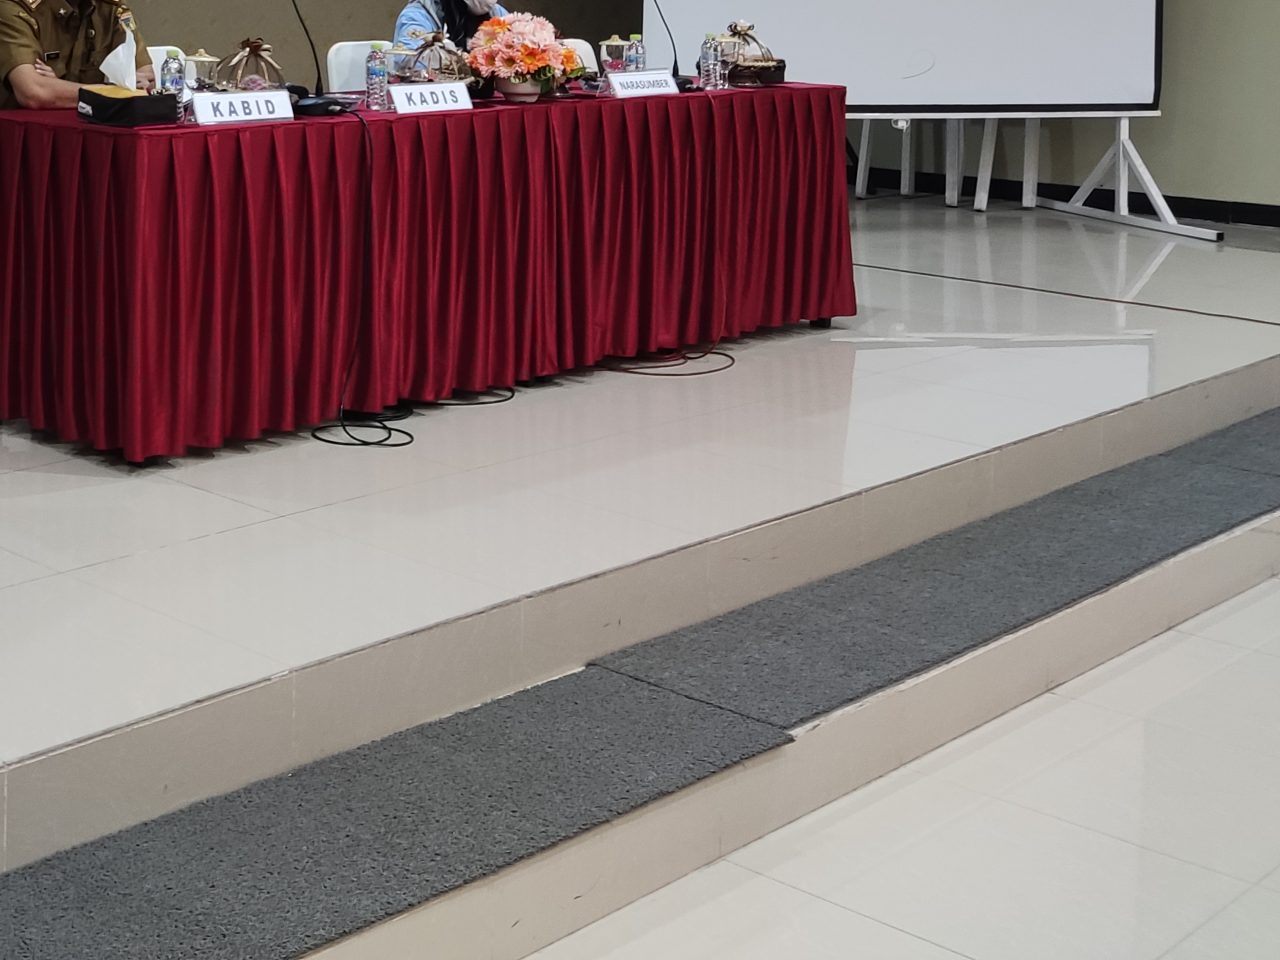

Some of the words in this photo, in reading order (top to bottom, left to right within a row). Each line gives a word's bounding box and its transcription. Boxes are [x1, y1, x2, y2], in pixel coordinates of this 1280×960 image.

[619, 78, 670, 91] NARASUMBER
[404, 89, 460, 106] KADIS
[210, 99, 277, 119] KABID
